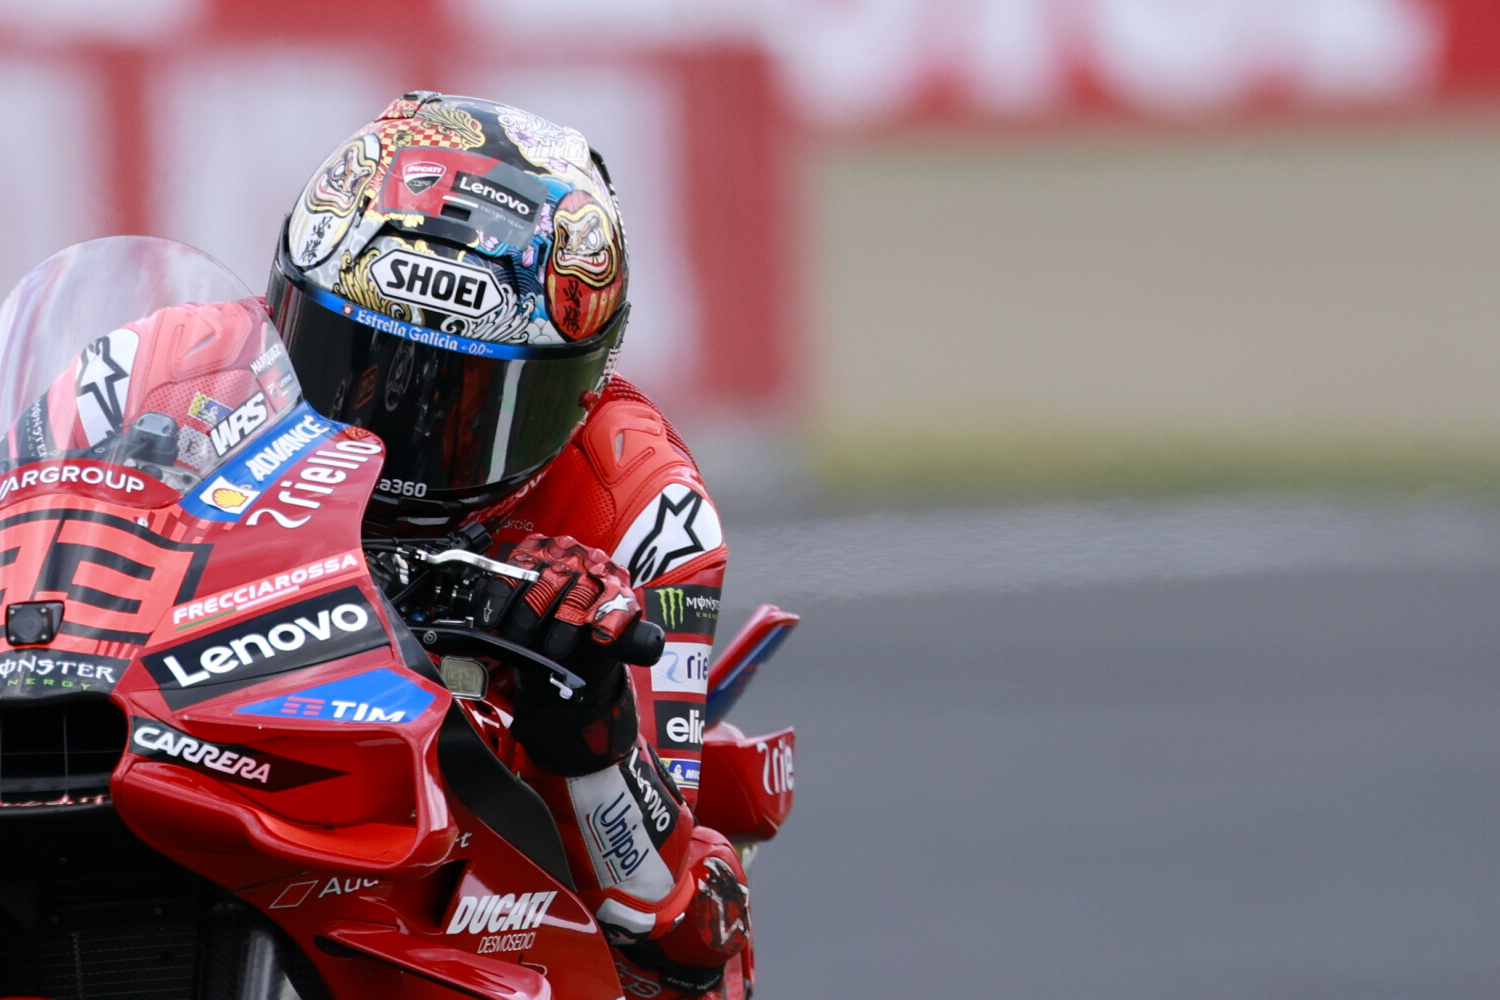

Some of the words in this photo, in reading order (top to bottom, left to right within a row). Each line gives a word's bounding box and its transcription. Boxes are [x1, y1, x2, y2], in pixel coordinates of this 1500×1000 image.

[407, 165, 443, 174] DUCATI
[459, 176, 530, 215] Lenovo
[386, 258, 487, 310] SHOEI
[355, 309, 406, 338] Estrella
[408, 327, 459, 350] Galicia
[250, 343, 282, 375] MARQUEZ
[210, 392, 268, 457] WRS
[245, 414, 330, 481] ADVANCE
[278, 440, 382, 509] riello
[378, 478, 427, 498] a360
[173, 554, 358, 625] FRECCIAROSSA
[163, 603, 368, 687] Lenovo
[331, 700, 406, 723] TIM
[134, 726, 271, 784] CARRERA
[600, 791, 649, 877] Unipol
[445, 891, 558, 935] DUCATI
[477, 931, 537, 954] DESMOSEDICI
